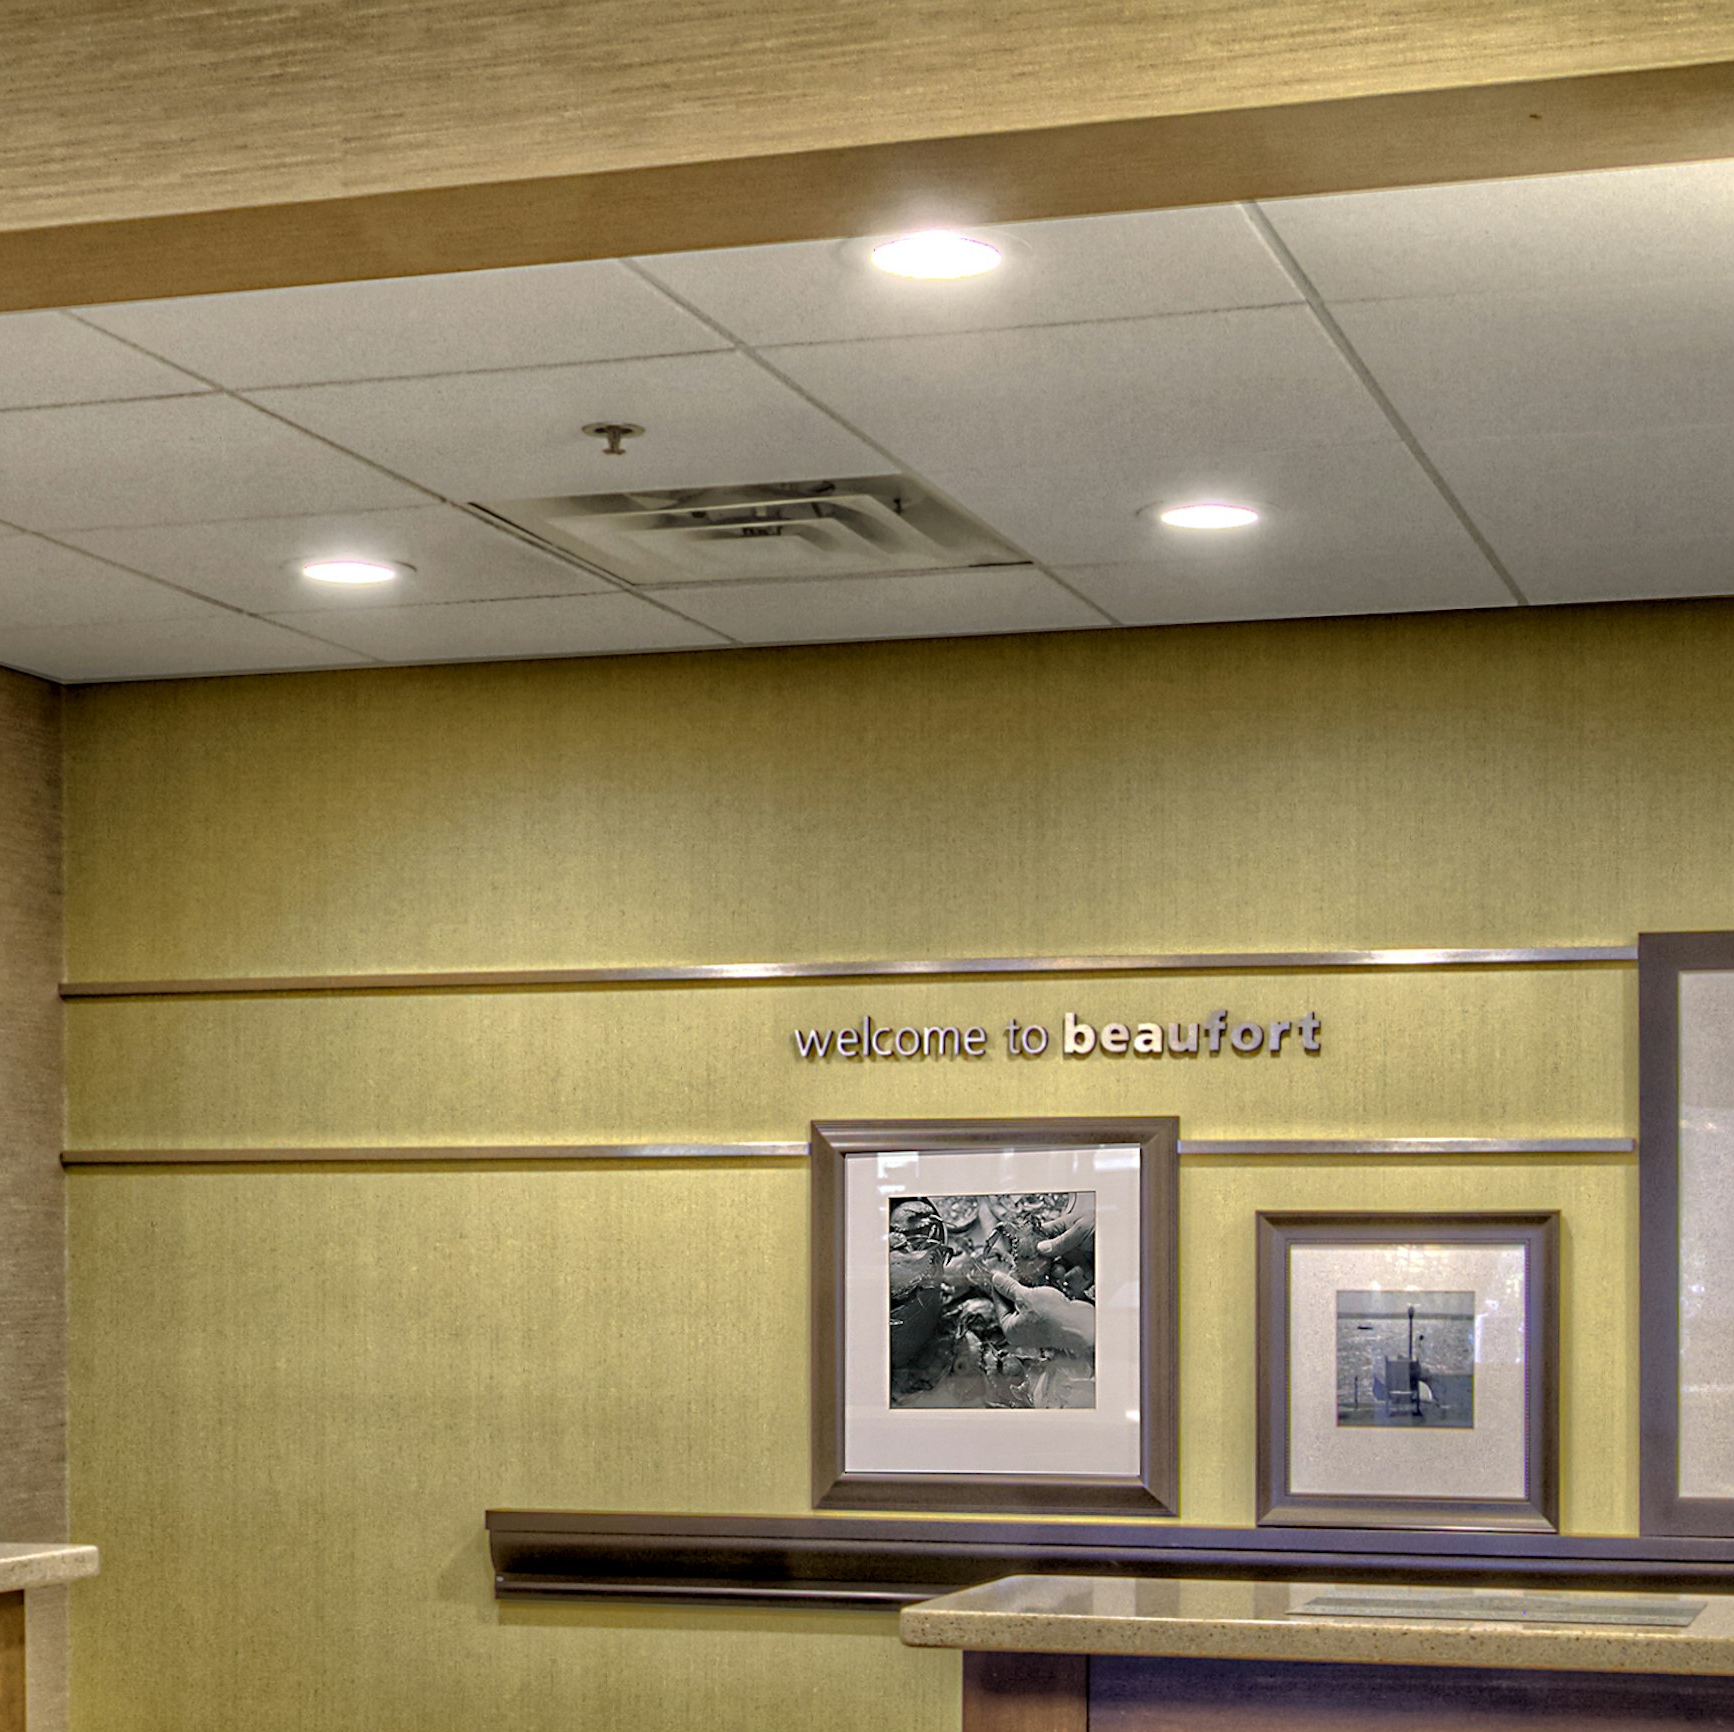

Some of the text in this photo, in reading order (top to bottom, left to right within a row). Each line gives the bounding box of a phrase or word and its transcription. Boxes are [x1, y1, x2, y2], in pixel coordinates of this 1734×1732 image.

[794, 1009, 1322, 1057] welcome to beaufort
